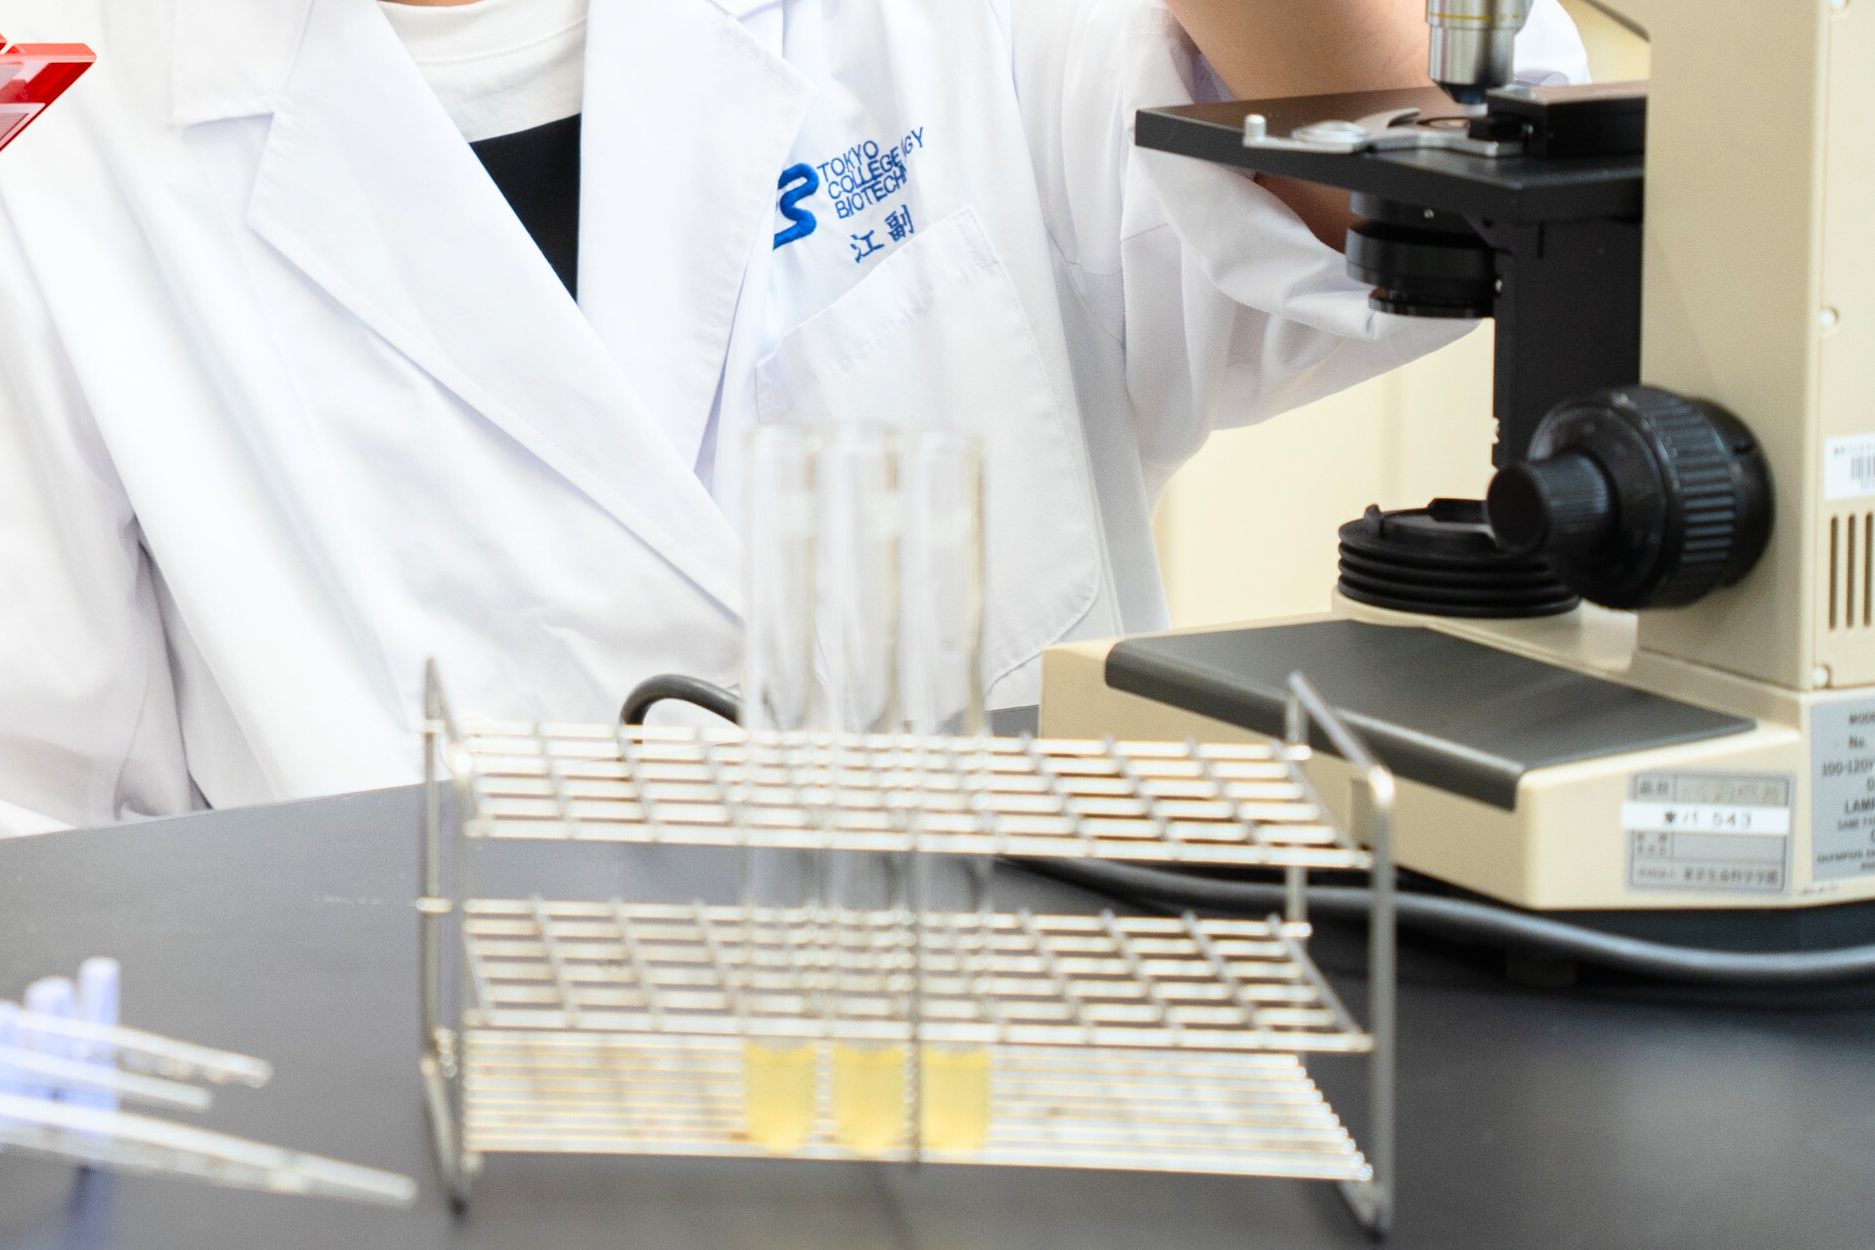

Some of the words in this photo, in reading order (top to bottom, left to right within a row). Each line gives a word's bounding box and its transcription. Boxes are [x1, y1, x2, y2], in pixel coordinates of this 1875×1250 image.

[817, 140, 879, 182] TOKYO
[828, 146, 900, 199] COLLEGE
[834, 126, 924, 219] BIOTECHGY
[850, 204, 915, 263] 江副
